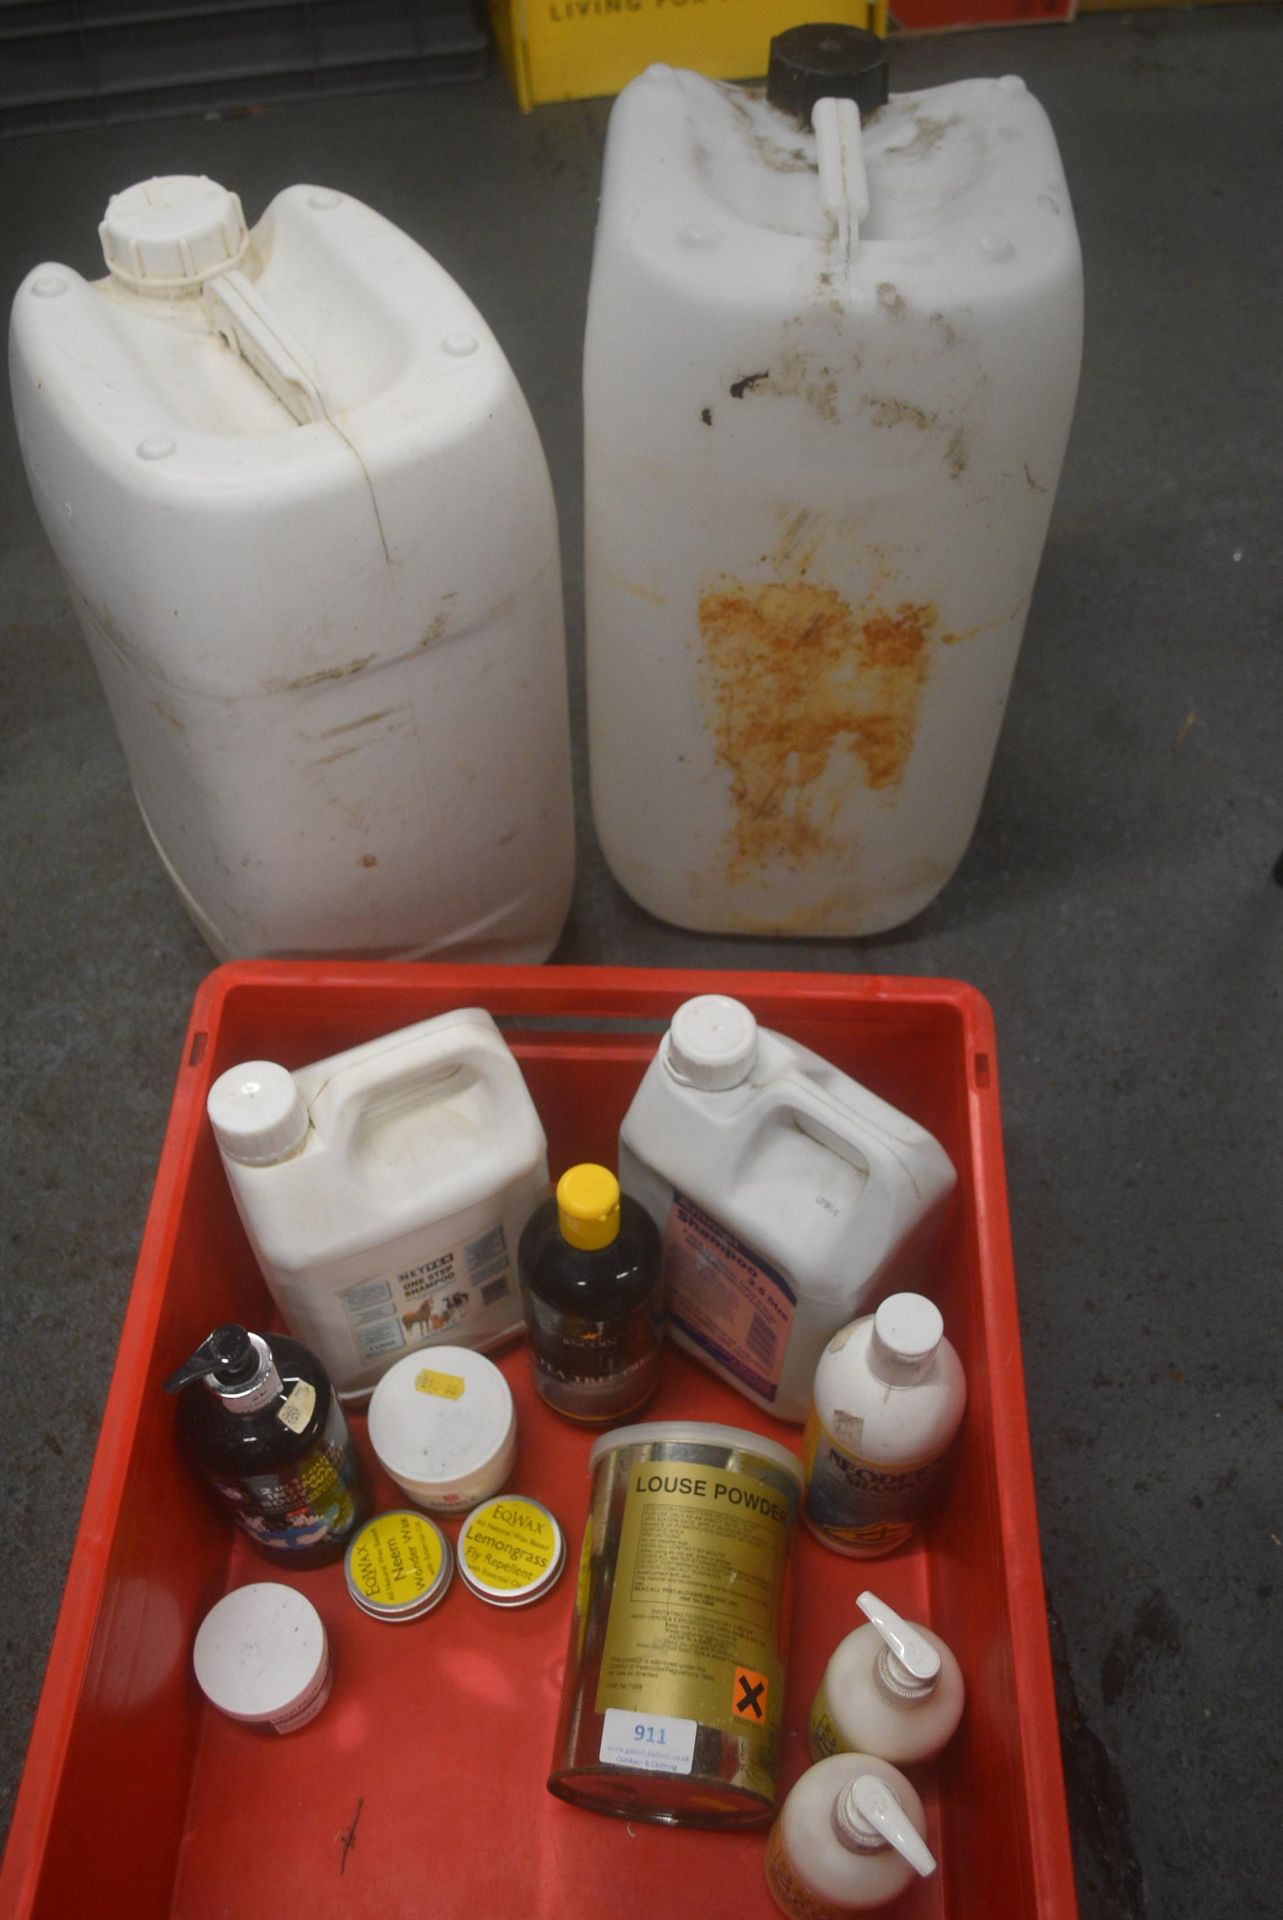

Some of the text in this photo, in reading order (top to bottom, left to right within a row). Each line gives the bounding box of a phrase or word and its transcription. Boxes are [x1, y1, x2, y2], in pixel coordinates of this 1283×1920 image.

[678, 1208, 757, 1277] Shampoo
[404, 1272, 455, 1297] SHAMPOO
[636, 1476, 707, 1497] LOUSE
[387, 1537, 407, 1582] Neem
[400, 1517, 426, 1591] Wonder Wax
[465, 1526, 547, 1568] Lemongrass
[467, 1546, 533, 1580] Fly Repellent
[634, 1724, 667, 1745] 911
